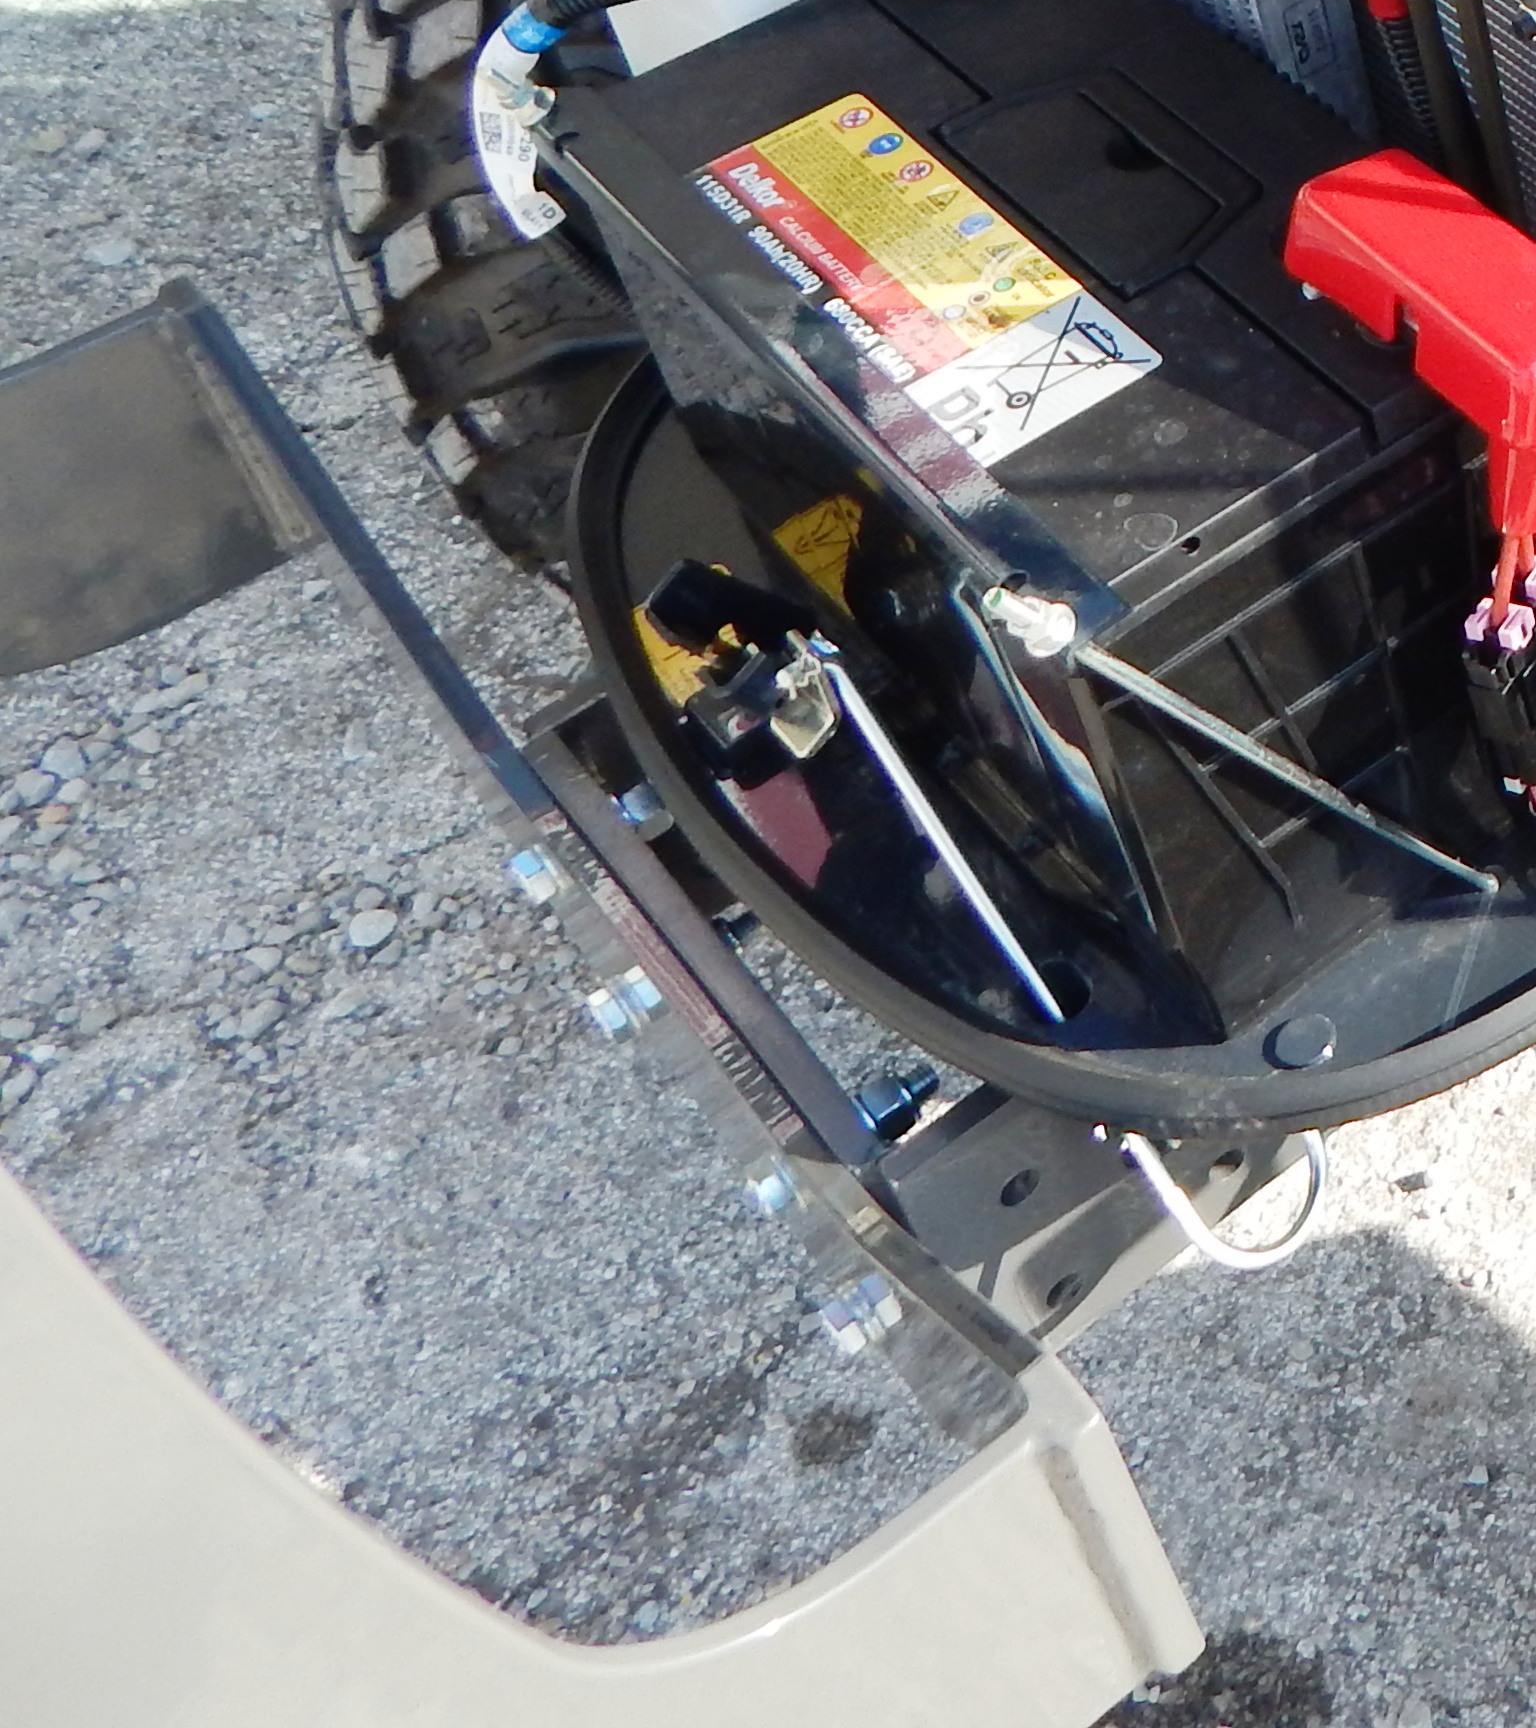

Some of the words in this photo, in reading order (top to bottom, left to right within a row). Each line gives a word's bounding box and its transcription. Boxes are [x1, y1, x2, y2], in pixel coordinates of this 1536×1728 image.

[728, 162, 786, 208] Delkor
[778, 216, 827, 256] CALCIUM
[817, 251, 865, 292] BATTERY
